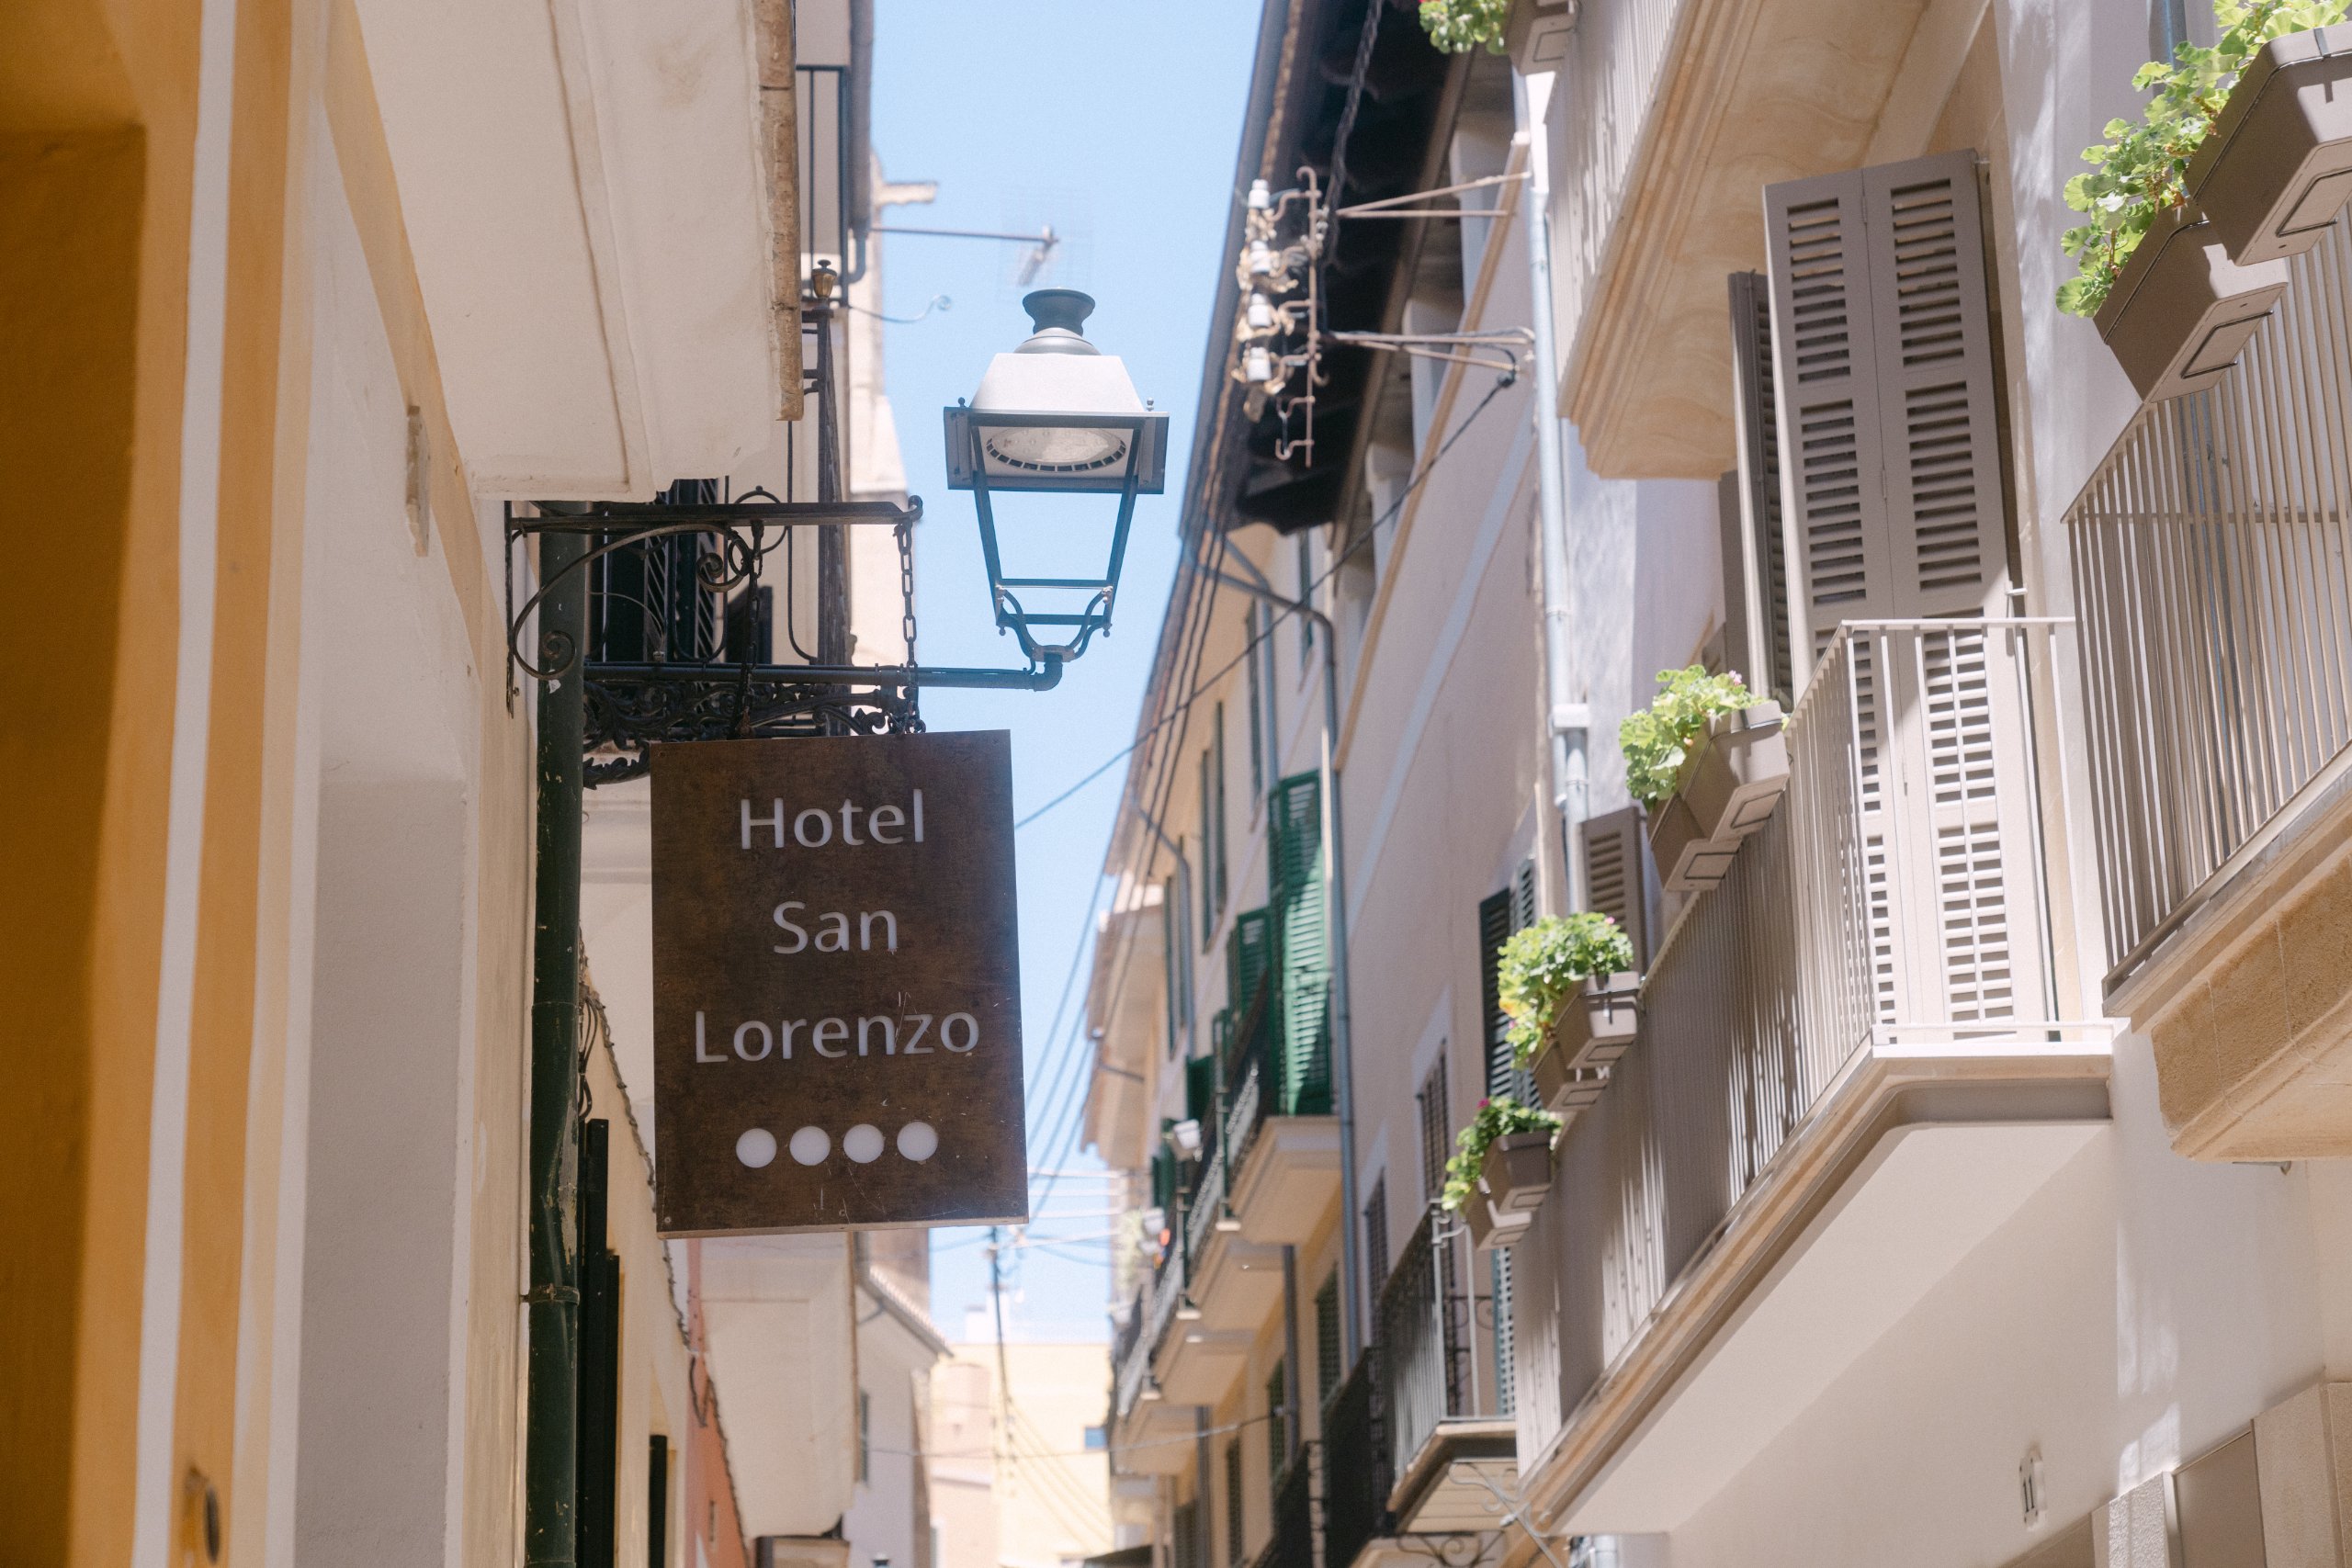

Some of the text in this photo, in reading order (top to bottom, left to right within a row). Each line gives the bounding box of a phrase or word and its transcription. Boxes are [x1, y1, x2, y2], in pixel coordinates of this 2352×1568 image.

[741, 789, 924, 849] Hotel
[773, 900, 899, 954] San
[695, 1011, 980, 1064] Lorenzo
[2023, 1475, 2035, 1512] 11
